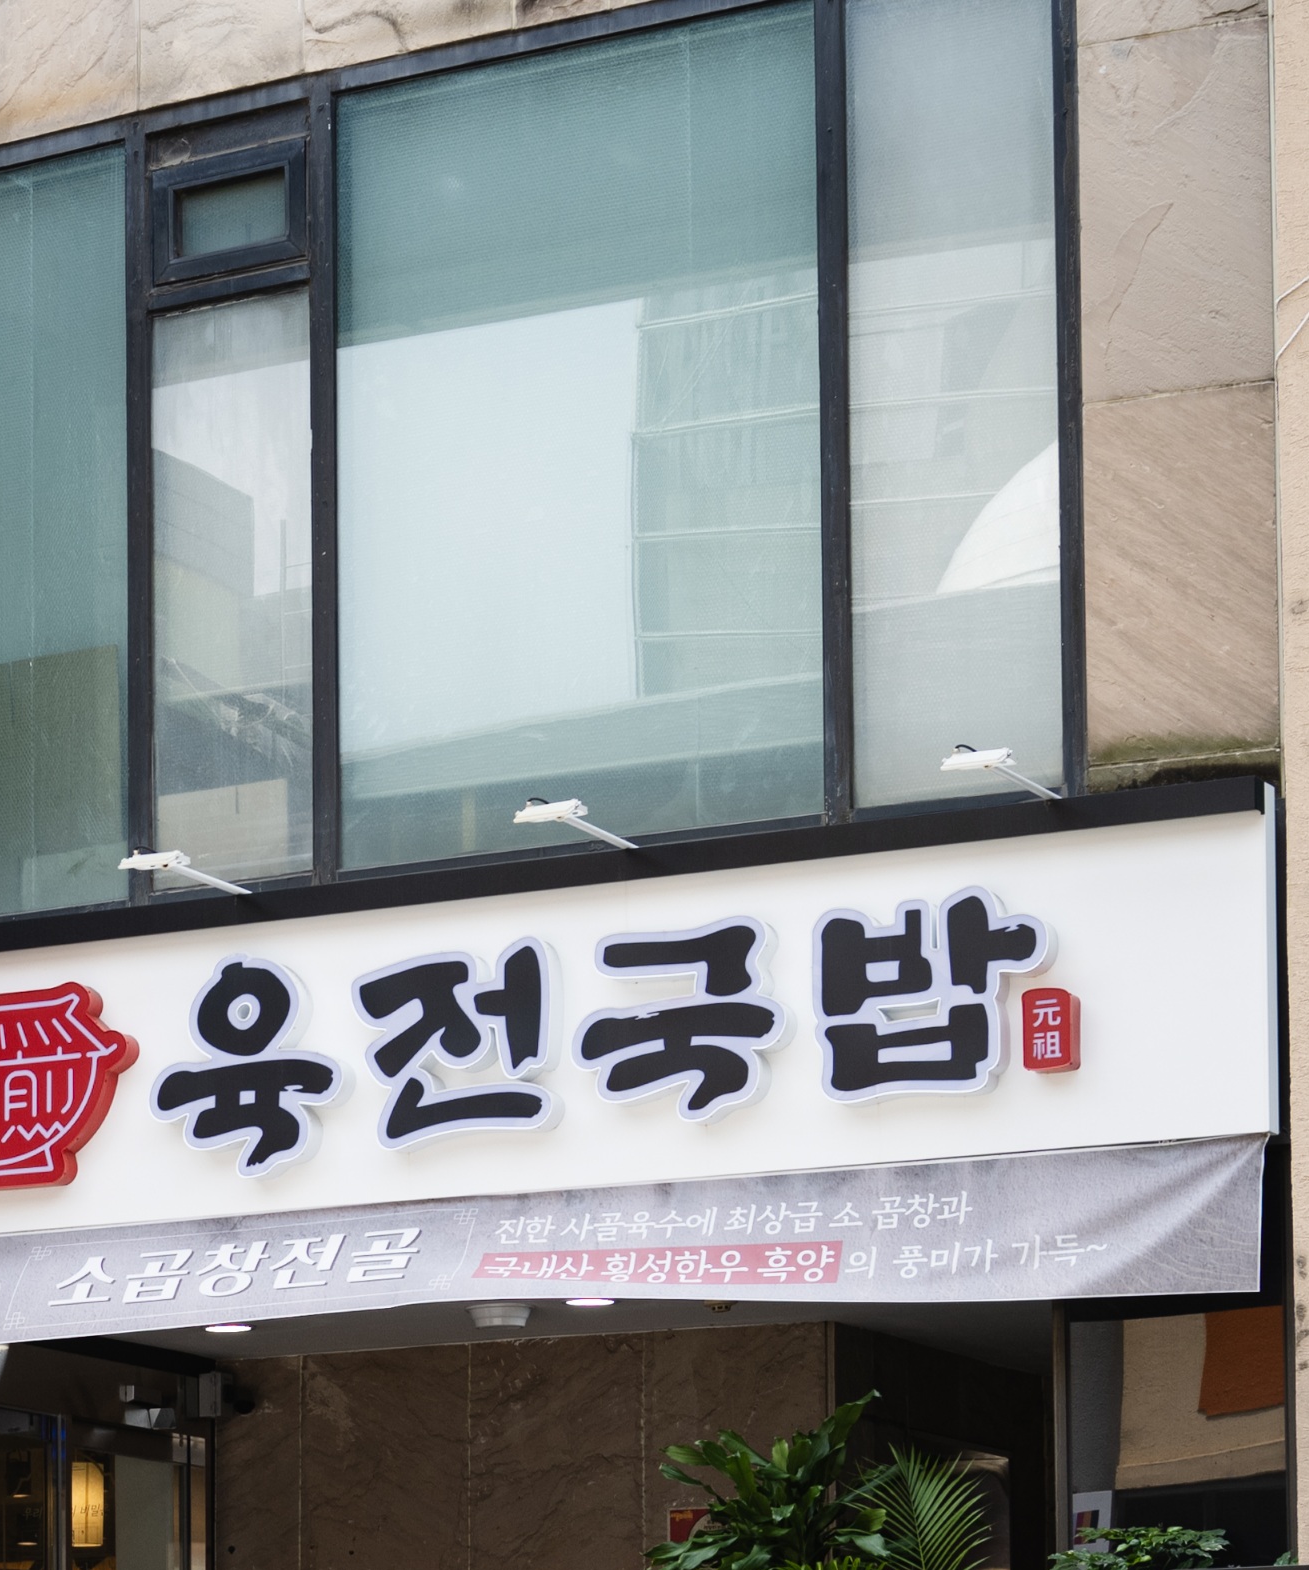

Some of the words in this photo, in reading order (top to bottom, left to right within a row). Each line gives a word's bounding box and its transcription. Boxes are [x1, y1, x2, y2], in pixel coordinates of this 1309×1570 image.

[153, 892, 1045, 1172] 육전국밥
[1029, 998, 1065, 1061] 元祖
[495, 1214, 555, 1245] 진한
[559, 1208, 716, 1243] 사골육수에
[724, 1200, 824, 1236] 최상급
[870, 1191, 973, 1229] 곱창과
[47, 1226, 424, 1306] 소곱창전골
[484, 1251, 595, 1283] 국내산
[600, 1247, 750, 1285] 횡성한우
[756, 1243, 837, 1284] 흑양
[845, 1244, 877, 1280] 의
[891, 1239, 998, 1283] 풍미가
